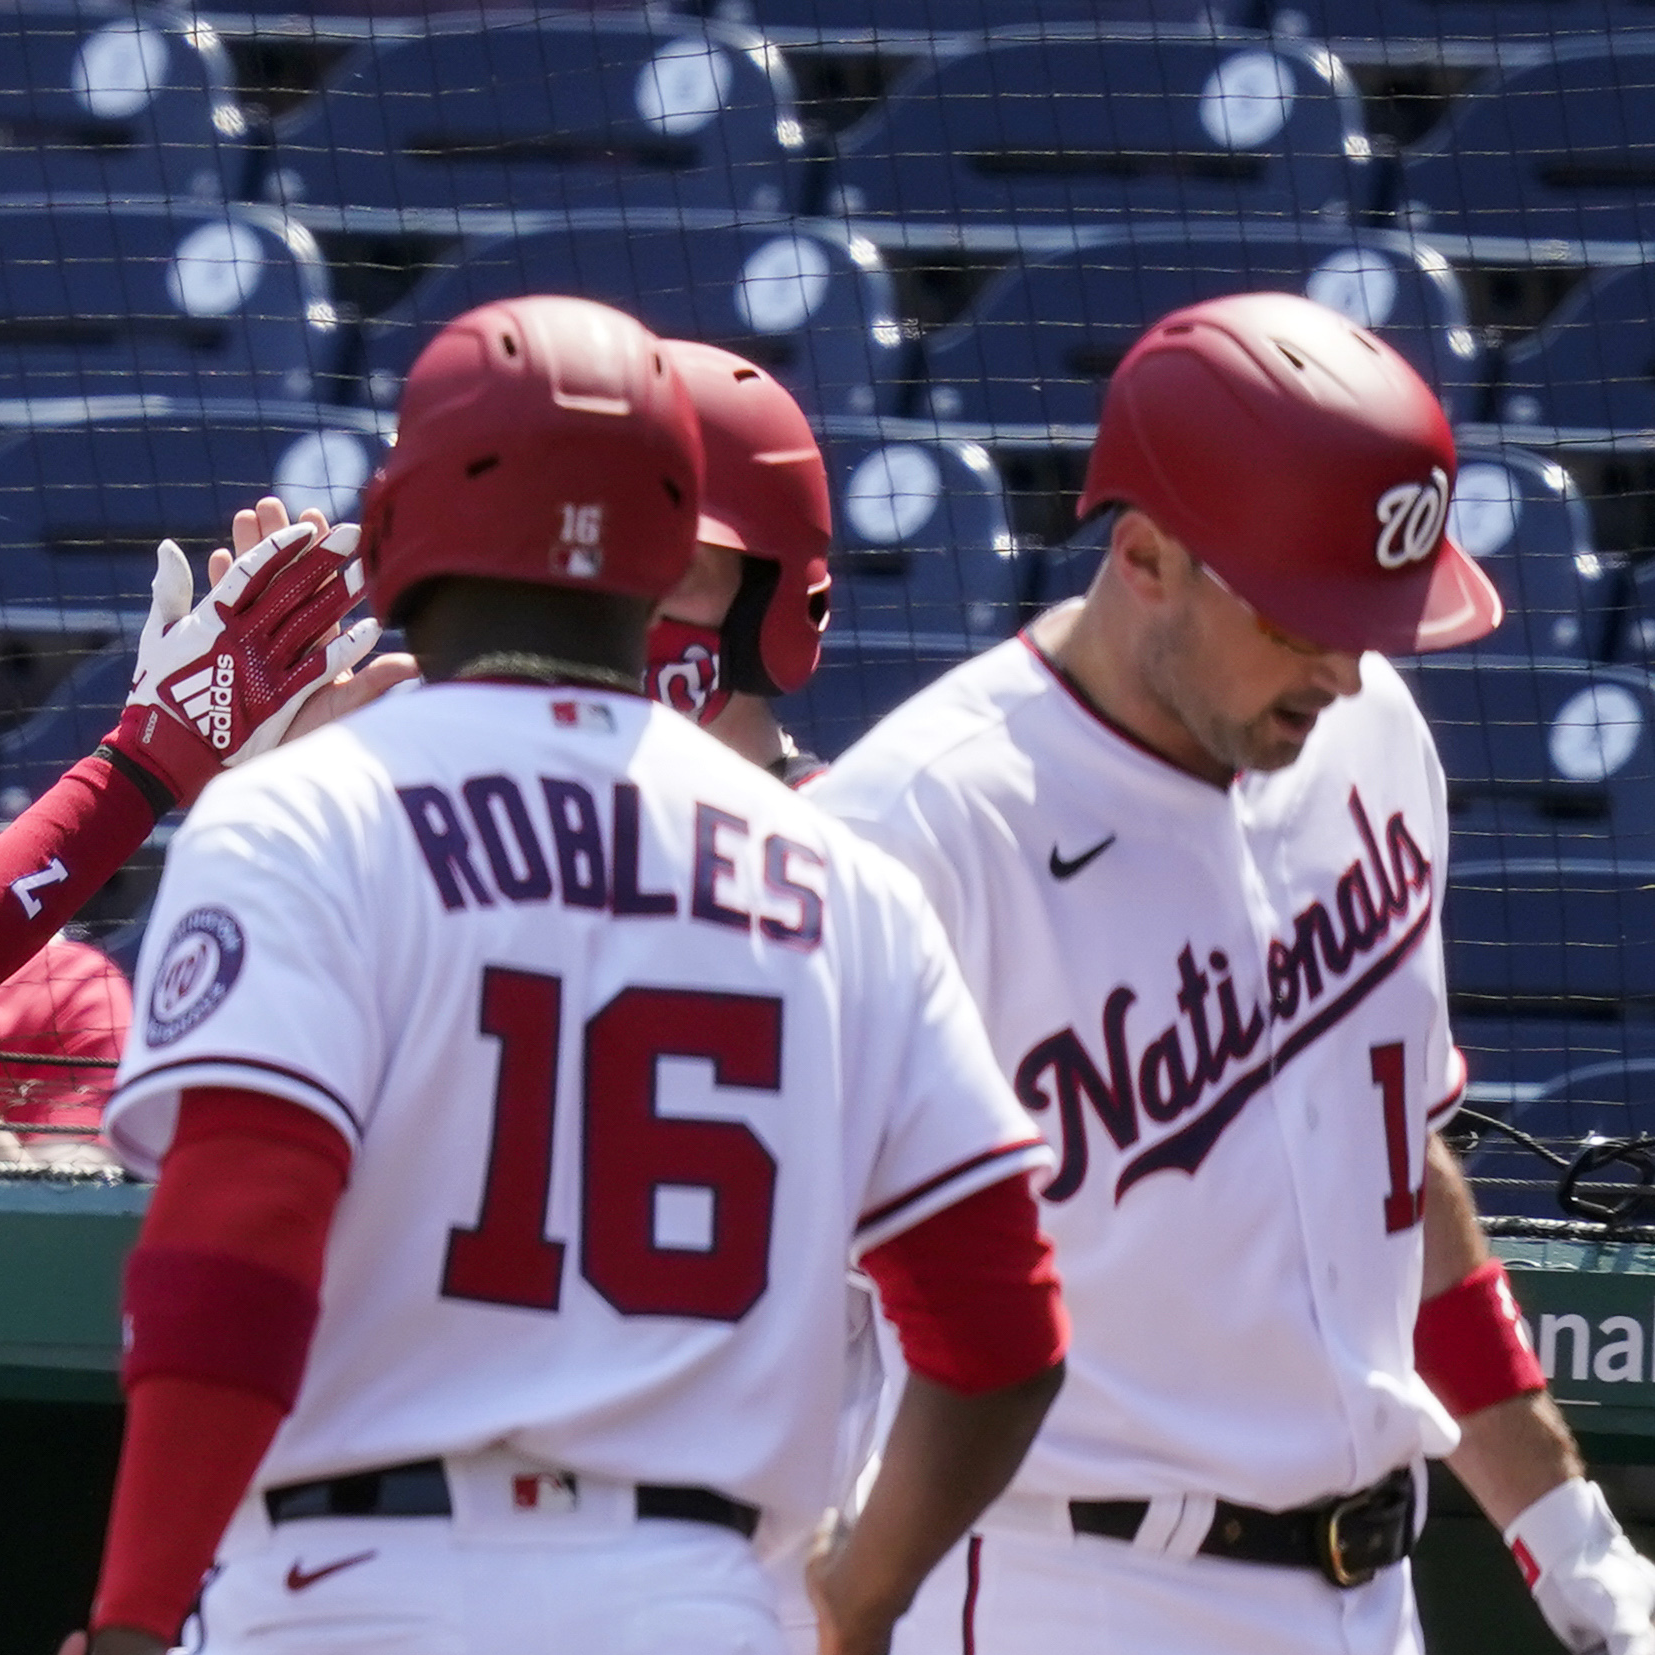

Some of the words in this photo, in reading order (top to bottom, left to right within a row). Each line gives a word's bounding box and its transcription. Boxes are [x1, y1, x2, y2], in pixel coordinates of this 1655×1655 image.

[559, 504, 603, 544] 16
[1377, 466, 1447, 569] W
[212, 654, 234, 749] adidas
[10, 857, 69, 920] 7
[395, 775, 828, 954] ROBLES
[1015, 784, 1434, 1202] Nationals
[439, 964, 784, 1323] 16
[1369, 1040, 1425, 1236] 1
